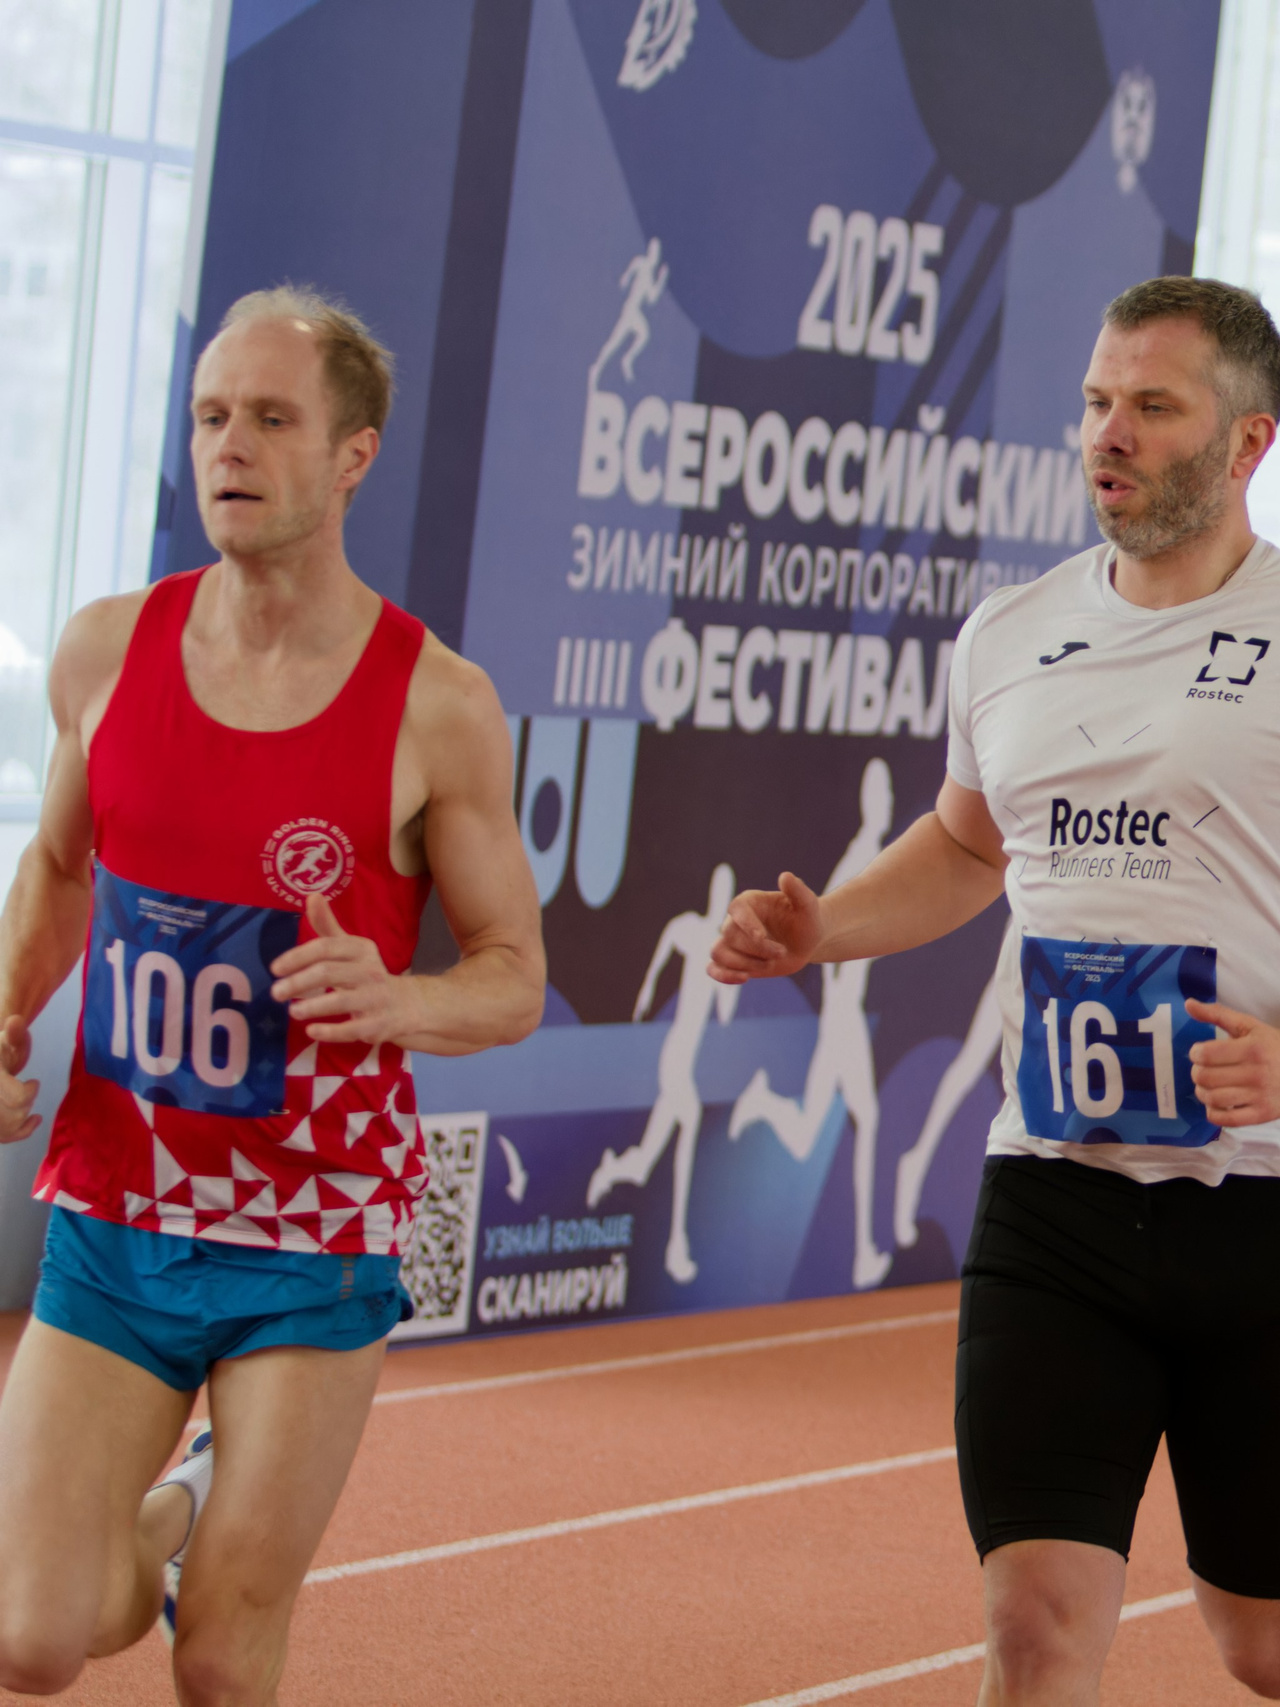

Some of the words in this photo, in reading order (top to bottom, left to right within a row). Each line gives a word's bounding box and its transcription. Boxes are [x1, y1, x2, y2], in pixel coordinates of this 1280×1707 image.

[797, 204, 944, 365] 2025
[577, 391, 1087, 546] ВСЕРОССИЙСКИЙ
[566, 522, 749, 601] ЗИМНИЙ
[758, 540, 1041, 618] КОРПОРАТИВ
[1186, 687, 1244, 704] Rostec
[272, 817, 328, 839] GOLDEN
[329, 825, 354, 854] RING
[1049, 798, 1170, 847] Rostec
[266, 876, 303, 907] ULTRA
[1049, 852, 1115, 878] Runners
[1121, 852, 1171, 880] Team
[105, 938, 252, 1087] 106
[1043, 997, 1178, 1119] 161
[483, 1215, 549, 1261] УЗНАЙ
[552, 1214, 634, 1252] БОЛЬШЕ
[477, 1252, 628, 1324] СКАНИРУЙ
